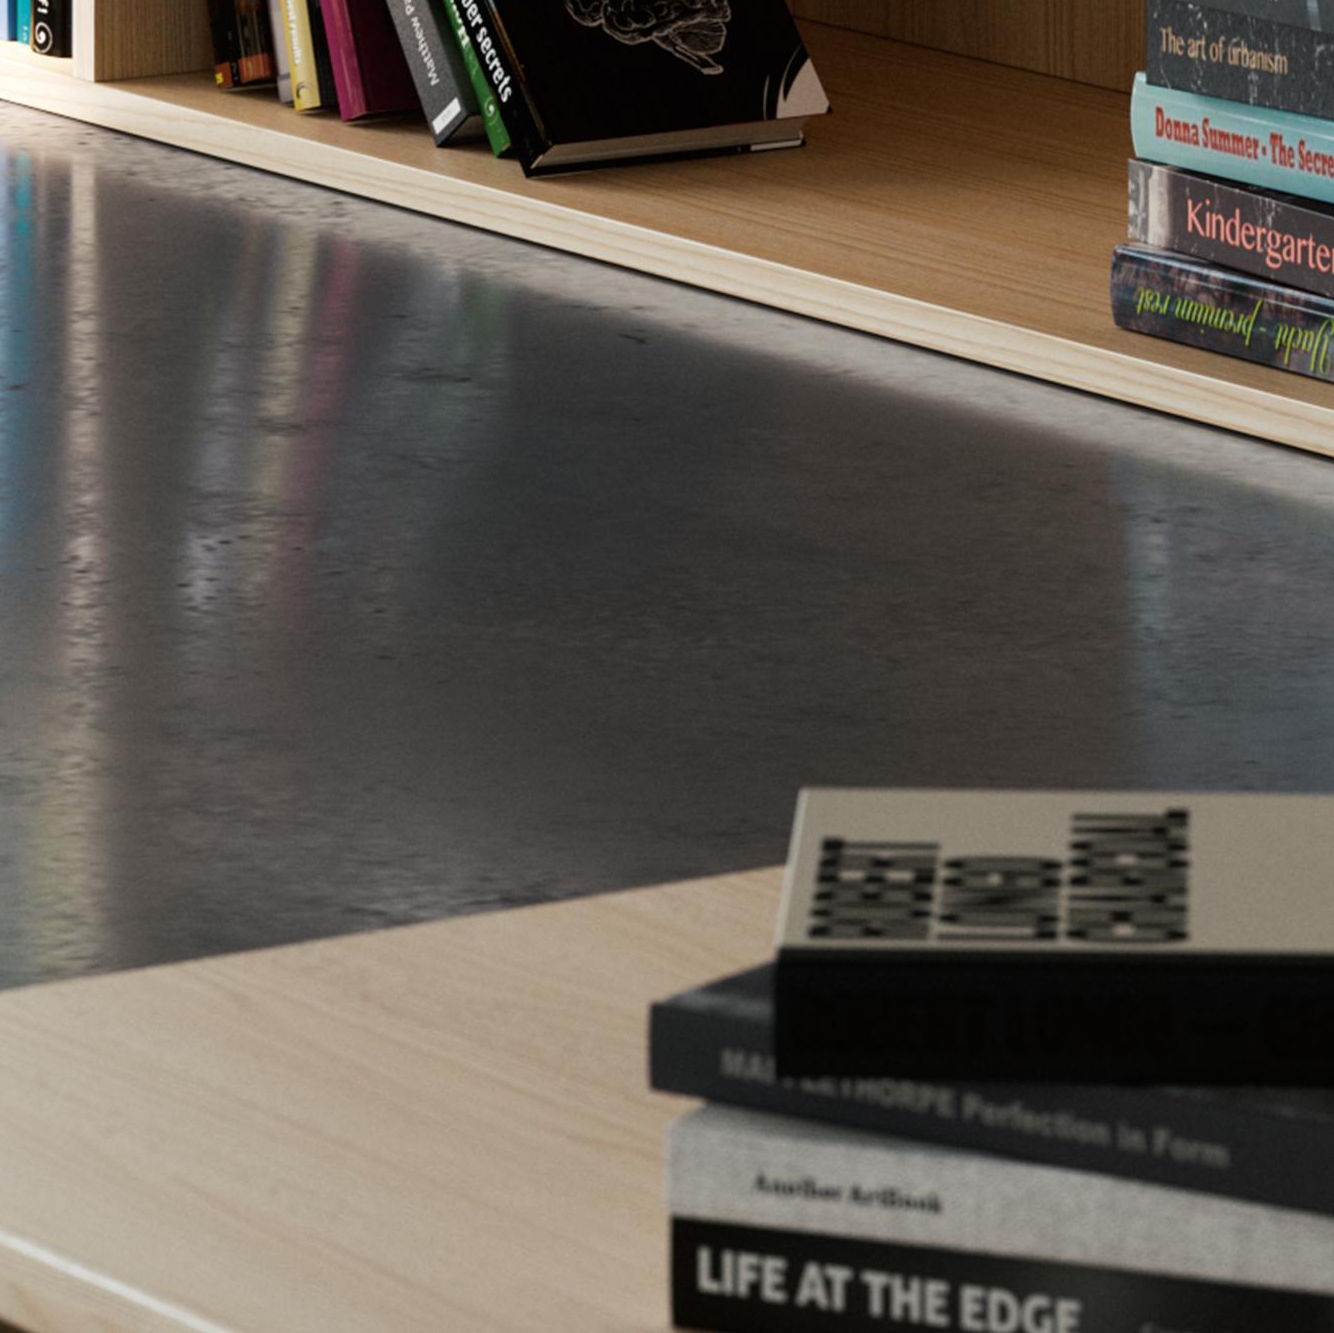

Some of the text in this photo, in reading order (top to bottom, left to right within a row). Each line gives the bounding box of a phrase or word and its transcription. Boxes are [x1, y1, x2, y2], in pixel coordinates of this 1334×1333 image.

[410, 16, 440, 86] Matthew
[475, 24, 513, 103] secrets
[1159, 25, 1288, 76] The art of urbanism
[1154, 105, 1200, 147] Donna
[1201, 117, 1260, 161] Summer
[1269, 132, 1296, 169] The
[1137, 288, 1170, 316] rest
[1174, 295, 1264, 347] premium
[961, 1091, 1115, 1153] Perfection
[1151, 1125, 1230, 1169] Form
[697, 1244, 1082, 1333] LIFE AT THE EDGE
